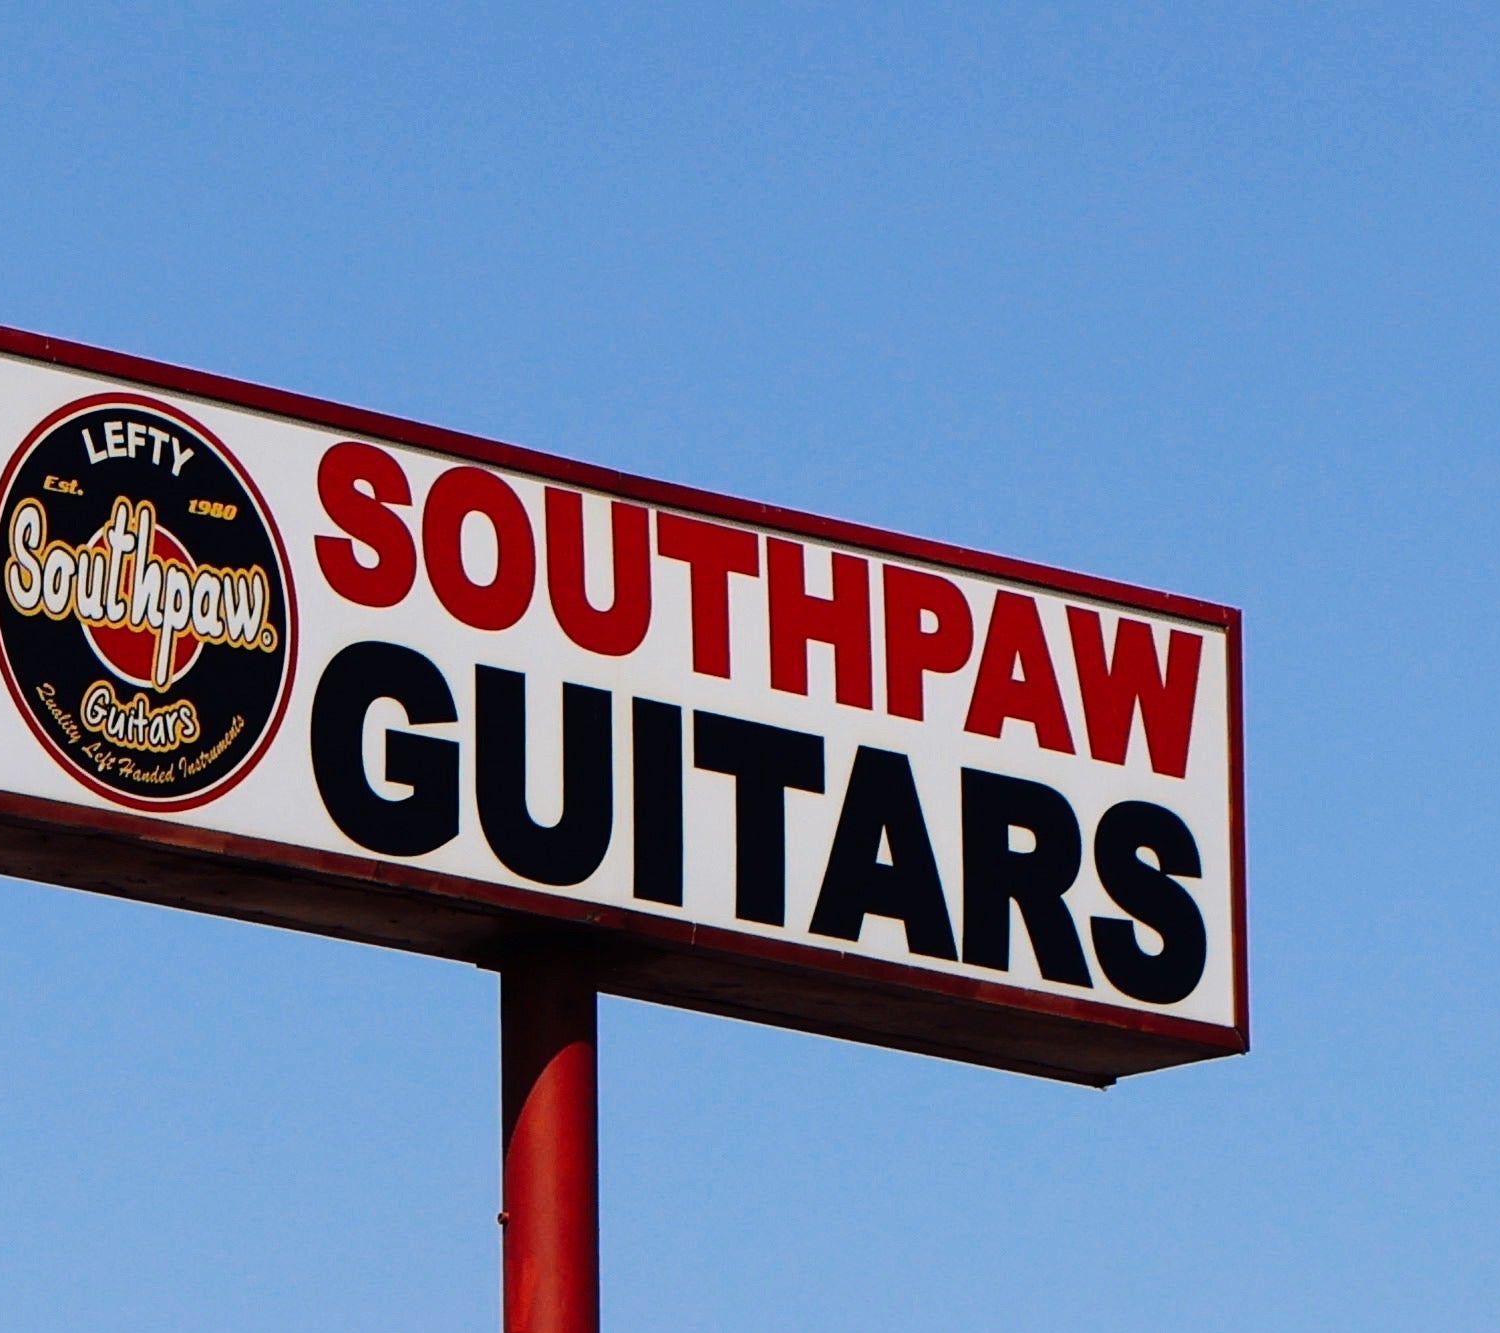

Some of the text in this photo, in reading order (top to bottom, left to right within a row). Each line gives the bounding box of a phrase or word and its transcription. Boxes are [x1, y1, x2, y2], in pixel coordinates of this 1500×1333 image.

[81, 420, 194, 477] LEFTY
[43, 475, 238, 521] Est. 1980
[313, 441, 1204, 780] SOUTHPAW
[82, 682, 198, 750] Guitars
[82, 740, 118, 772] Left
[117, 756, 175, 784] Handed
[178, 712, 246, 778] Instruments
[310, 640, 1207, 1005] GUITARS
